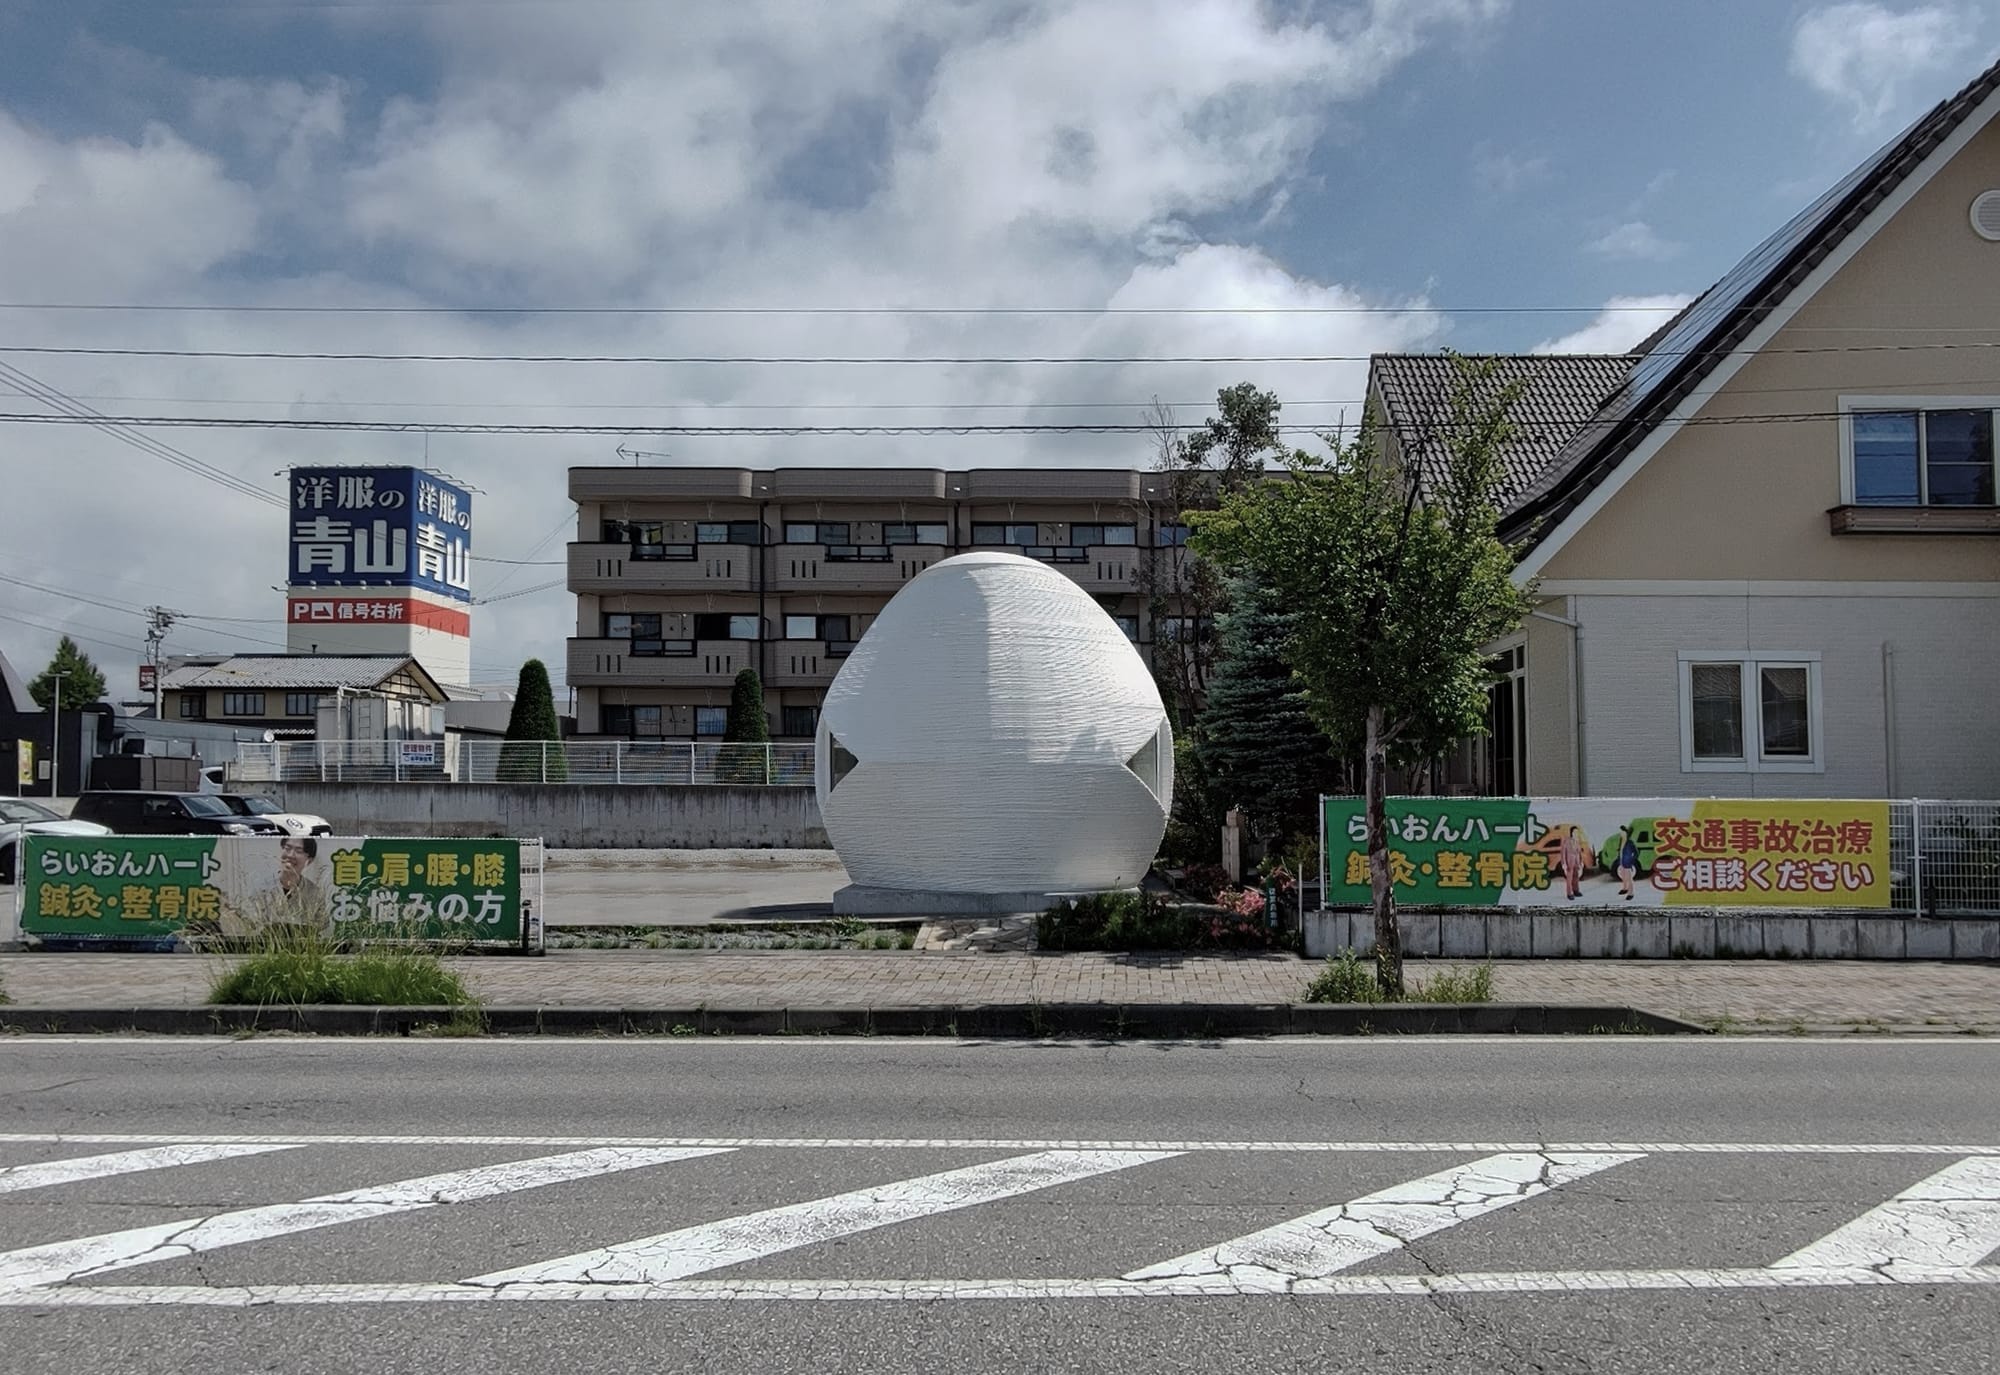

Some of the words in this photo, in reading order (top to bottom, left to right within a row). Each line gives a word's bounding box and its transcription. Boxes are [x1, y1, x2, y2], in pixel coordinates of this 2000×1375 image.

[297, 476, 404, 509] 洋服の
[418, 479, 471, 531] 洋服の
[292, 516, 407, 573] 青山
[416, 522, 471, 591] 青山
[337, 602, 403, 619] 信号右折
[1655, 817, 1874, 854] 交通事故治療
[40, 849, 219, 877] らいおんハート
[1653, 858, 1875, 890] ご相談ください
[39, 882, 221, 919] 鍼灸・整骨院
[333, 888, 506, 925] お悩みの方
